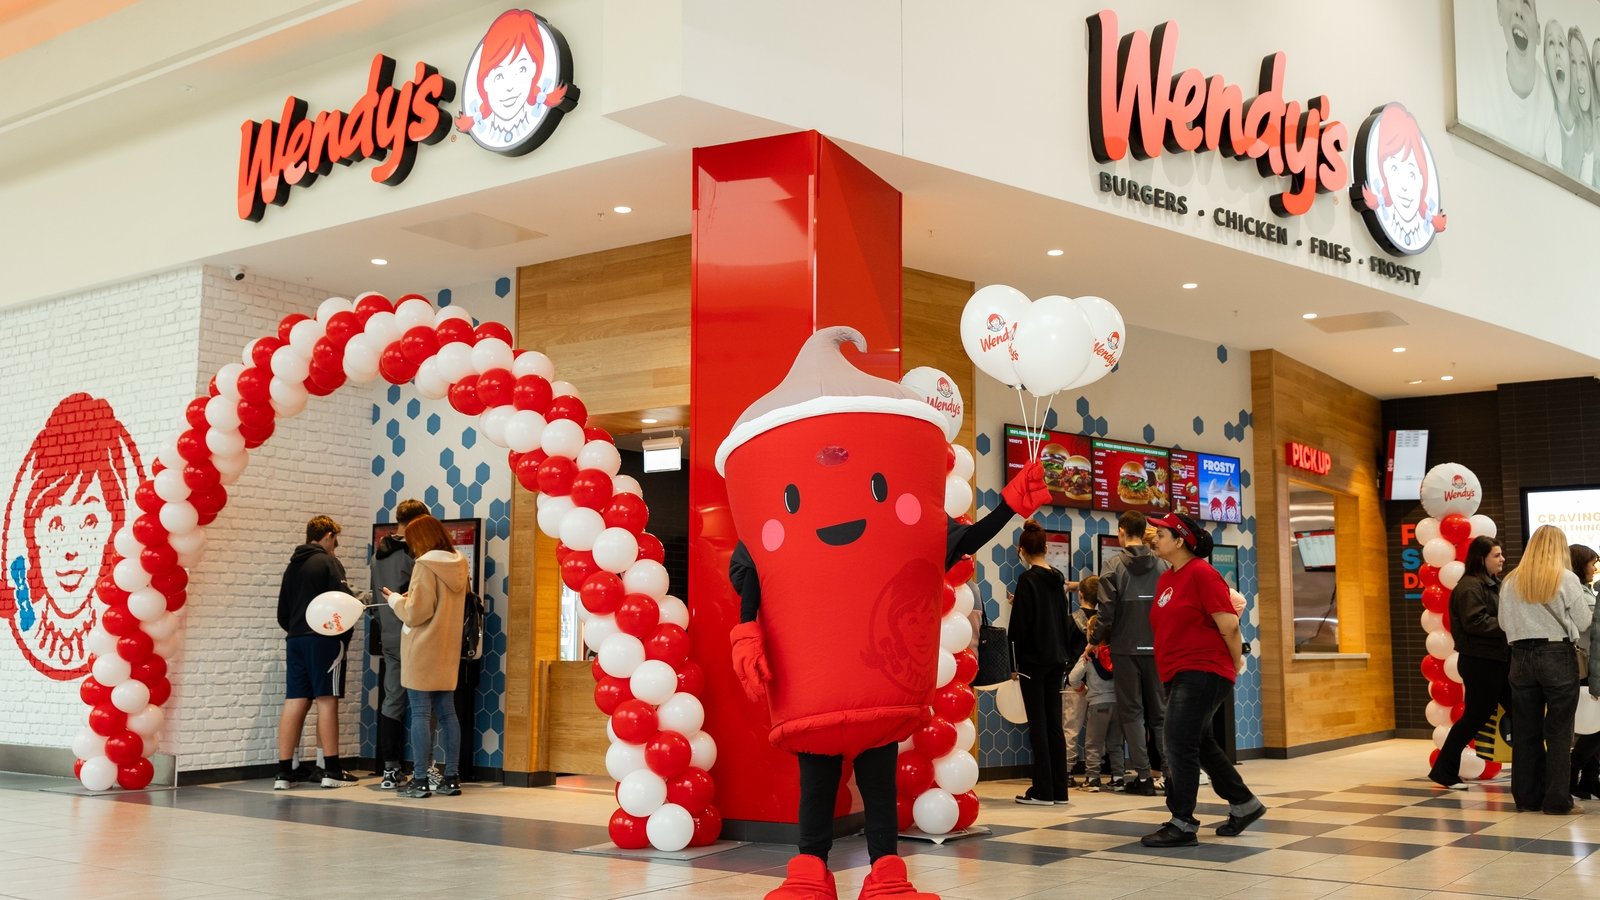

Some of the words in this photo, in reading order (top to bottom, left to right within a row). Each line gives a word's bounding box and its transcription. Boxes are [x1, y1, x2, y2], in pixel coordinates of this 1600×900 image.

[237, 53, 446, 220] Wendy's
[1090, 9, 1348, 216] Wendy's
[1099, 171, 1188, 215] BURGERS
[1213, 207, 1288, 246] CHICKEN
[1310, 237, 1351, 264] FRIES
[1370, 255, 1421, 286] FROSTY
[980, 327, 1009, 352] Wend
[1203, 459, 1236, 474] FROSTY
[1444, 487, 1475, 502] Wendy's
